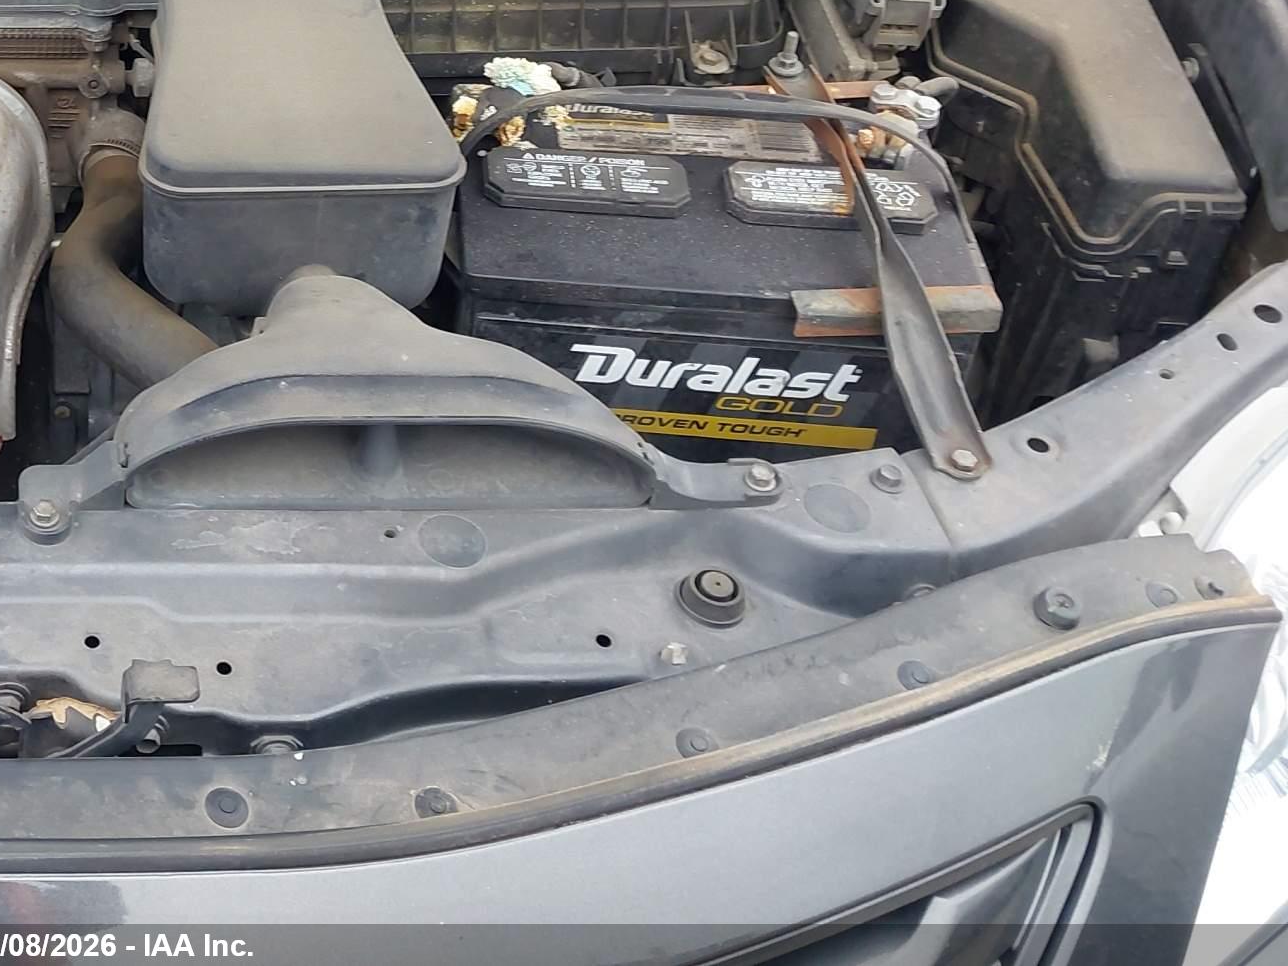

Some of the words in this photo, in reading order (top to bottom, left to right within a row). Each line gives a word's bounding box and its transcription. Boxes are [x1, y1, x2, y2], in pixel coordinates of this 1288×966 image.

[535, 153, 587, 164] DANGER
[598, 157, 645, 166] POISON
[570, 343, 862, 402] Duralast
[715, 396, 844, 418] GOLD
[717, 422, 805, 438] TOUGH
